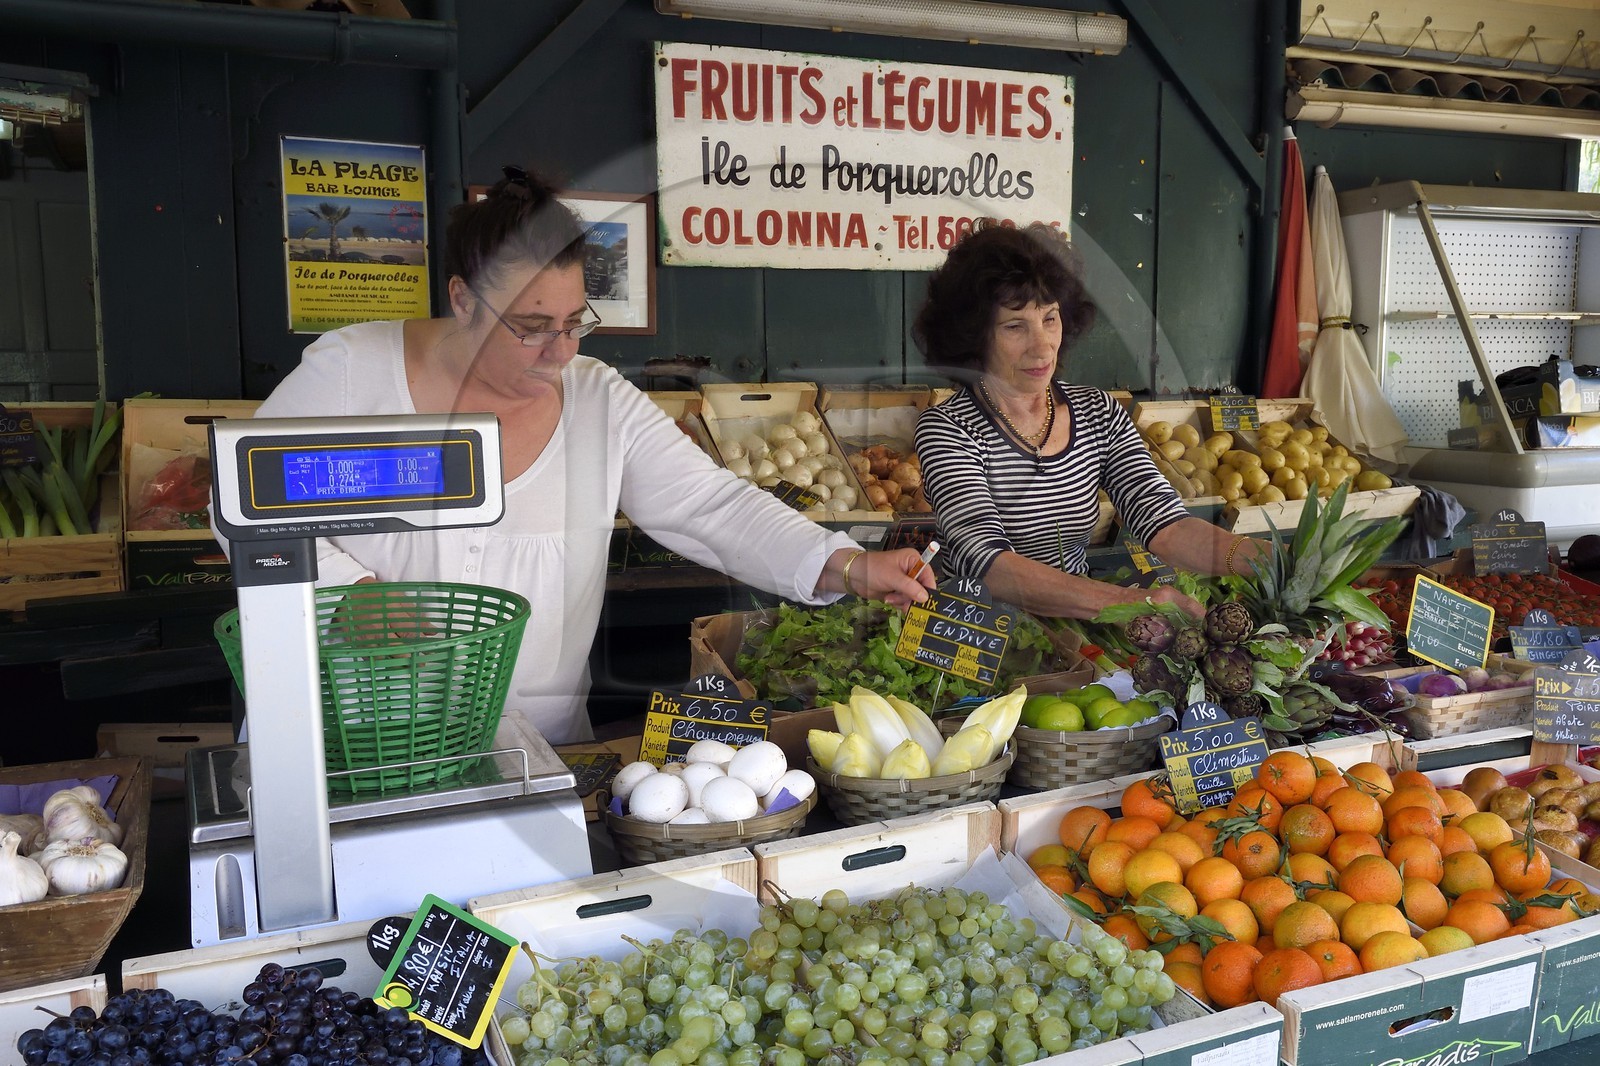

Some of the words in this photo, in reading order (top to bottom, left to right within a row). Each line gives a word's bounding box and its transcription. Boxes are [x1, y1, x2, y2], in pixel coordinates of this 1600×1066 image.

[671, 58, 827, 125] FRUITS
[833, 86, 859, 128] et
[289, 158, 326, 177] LA
[333, 161, 419, 182] PLAGE
[769, 145, 807, 189] de
[822, 144, 1035, 205] Porquerolles
[305, 182, 339, 194] BAR
[343, 184, 400, 197] LOUNGE
[681, 206, 869, 249] COLONNA
[320, 268, 335, 279] de
[338, 269, 419, 284] Porquerolles
[317, 487, 336, 495] PRIX
[339, 486, 367, 494] DIRECT
[1498, 510, 1515, 522] 1kg
[1508, 526, 1517, 535] €
[957, 578, 982, 597] 1Kg
[1433, 590, 1472, 613] NAVET
[907, 612, 926, 629] Produit
[942, 600, 985, 625] 4,80
[994, 614, 1011, 632] €
[1529, 610, 1548, 625] 1Kg
[902, 629, 920, 645] Variété
[1413, 625, 1440, 647] 4,00
[1457, 642, 1476, 657] Euros
[1510, 630, 1529, 646] Prix
[695, 674, 724, 692] 1Kg
[1536, 677, 1560, 694] Prix
[649, 691, 681, 714] Prix
[685, 699, 738, 722] 6,50
[749, 706, 767, 724] €
[1190, 702, 1217, 721] 1Kg
[646, 718, 671, 735] Produit
[645, 737, 666, 752] Variété
[1160, 735, 1190, 756] Prix
[1192, 729, 1233, 751] 5,00
[1244, 721, 1261, 739] €
[1168, 762, 1191, 779] Produit
[1196, 776, 1227, 791] Feuille
[439, 912, 449, 921] €
[371, 924, 401, 951] 1kg
[417, 999, 432, 1017] Produit
[430, 1004, 446, 1024] Variété
[1315, 1003, 1406, 1031] www.satlamoreneta.com
[443, 1012, 458, 1030] Origine
